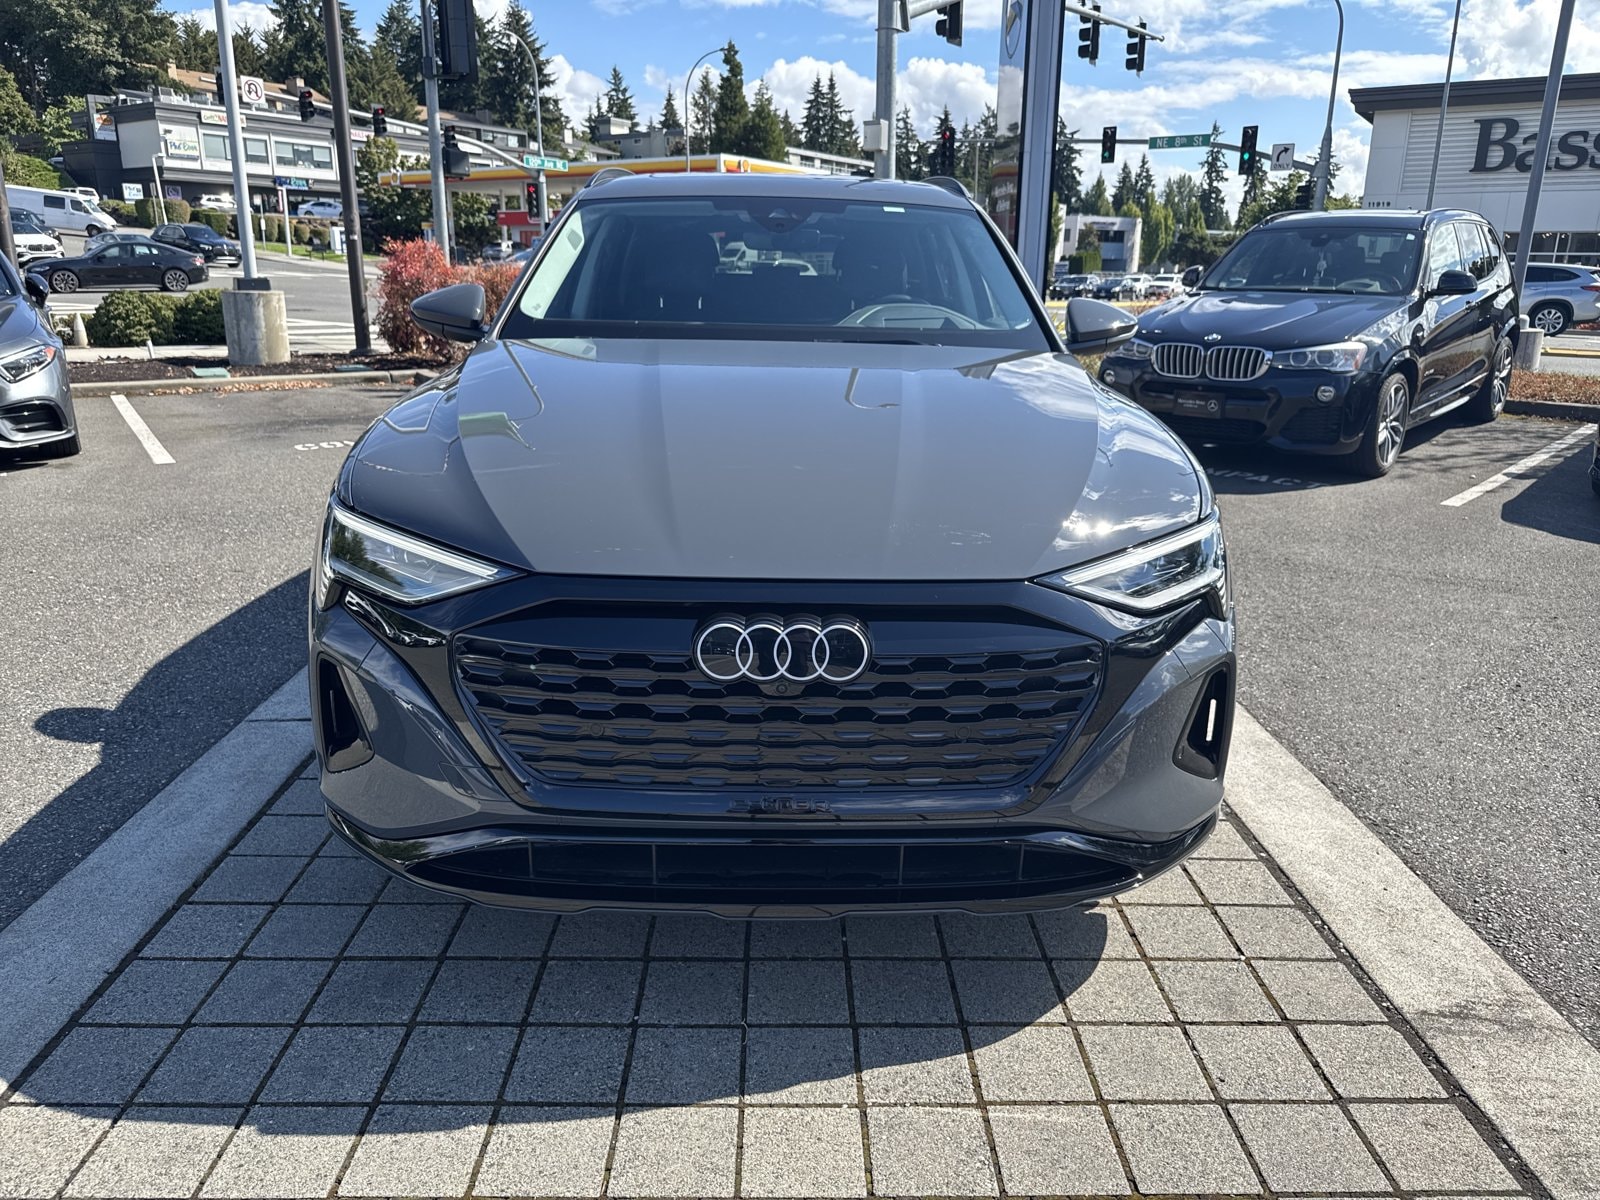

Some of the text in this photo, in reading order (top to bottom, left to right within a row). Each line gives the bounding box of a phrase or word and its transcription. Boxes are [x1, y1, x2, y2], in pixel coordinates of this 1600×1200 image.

[1156, 135, 1203, 148] NE 8th St
